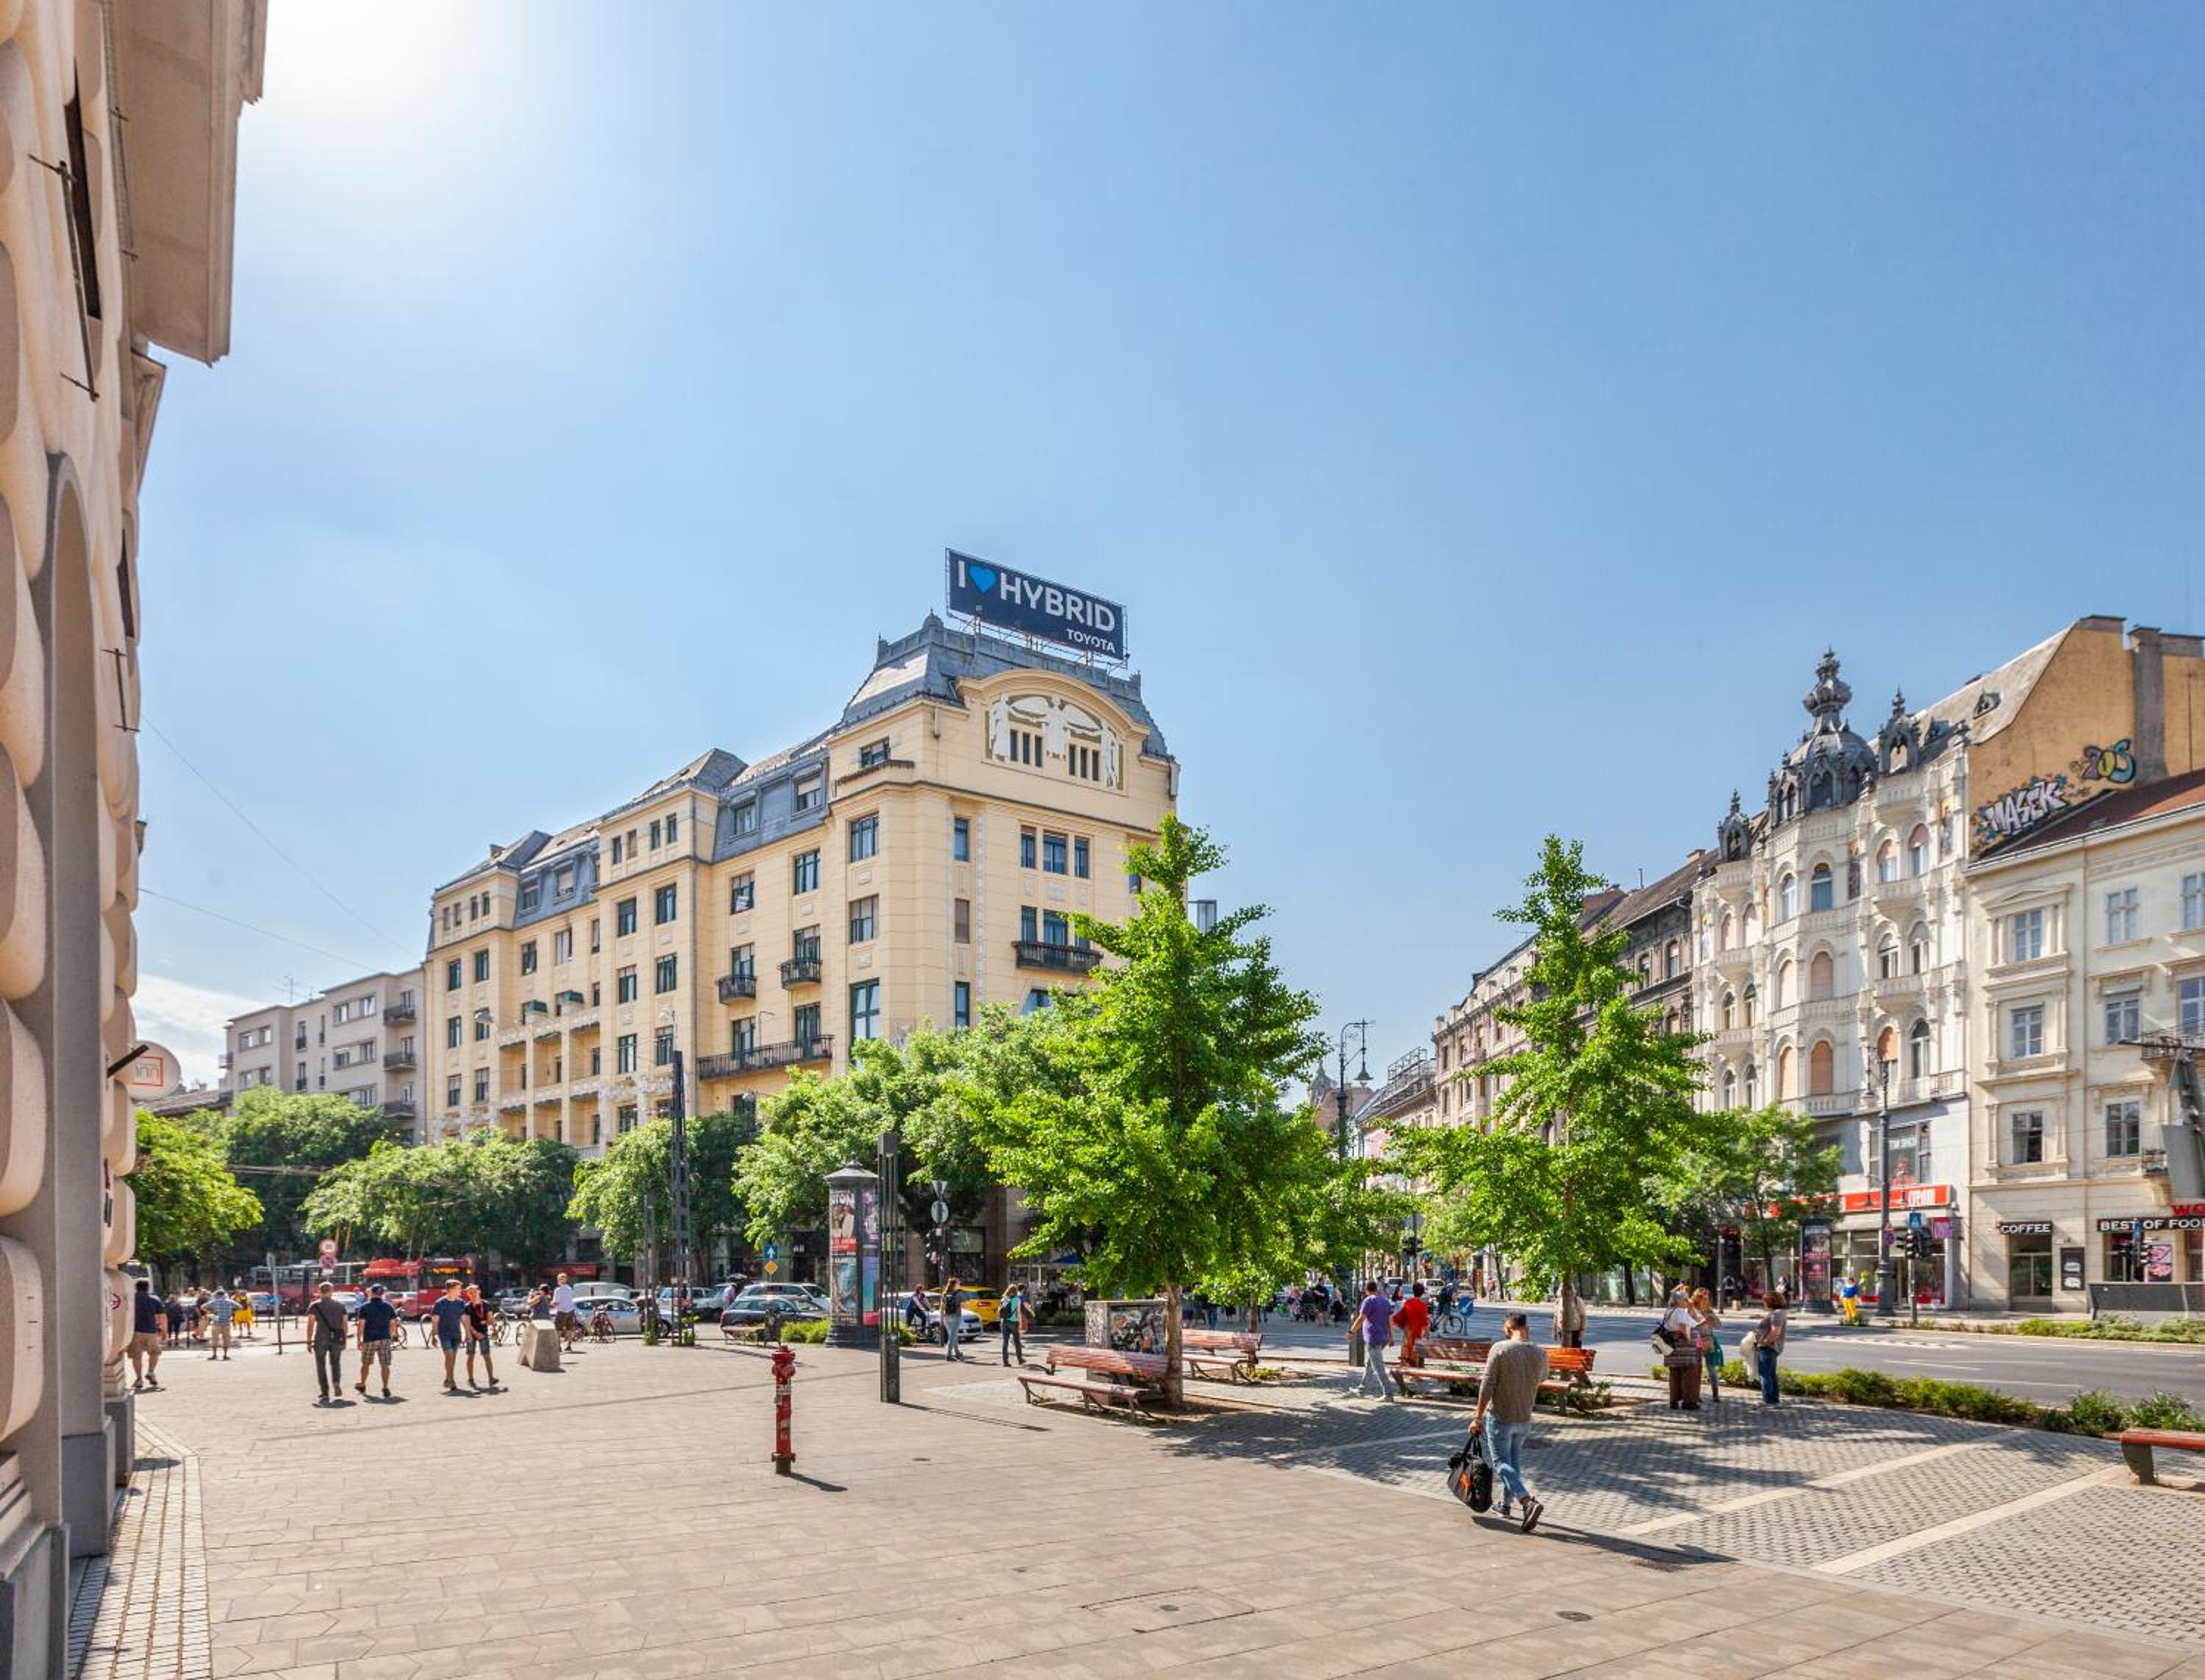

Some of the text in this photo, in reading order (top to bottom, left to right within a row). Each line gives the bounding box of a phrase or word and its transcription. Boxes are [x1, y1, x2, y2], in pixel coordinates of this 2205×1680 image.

[957, 560, 1116, 632] I HYBRID
[1066, 628, 1116, 654] TOYOTA
[2000, 1223, 2051, 1234] COFFEE
[2100, 1220, 2138, 1231] BEST
[2143, 1219, 2165, 1230] OF
